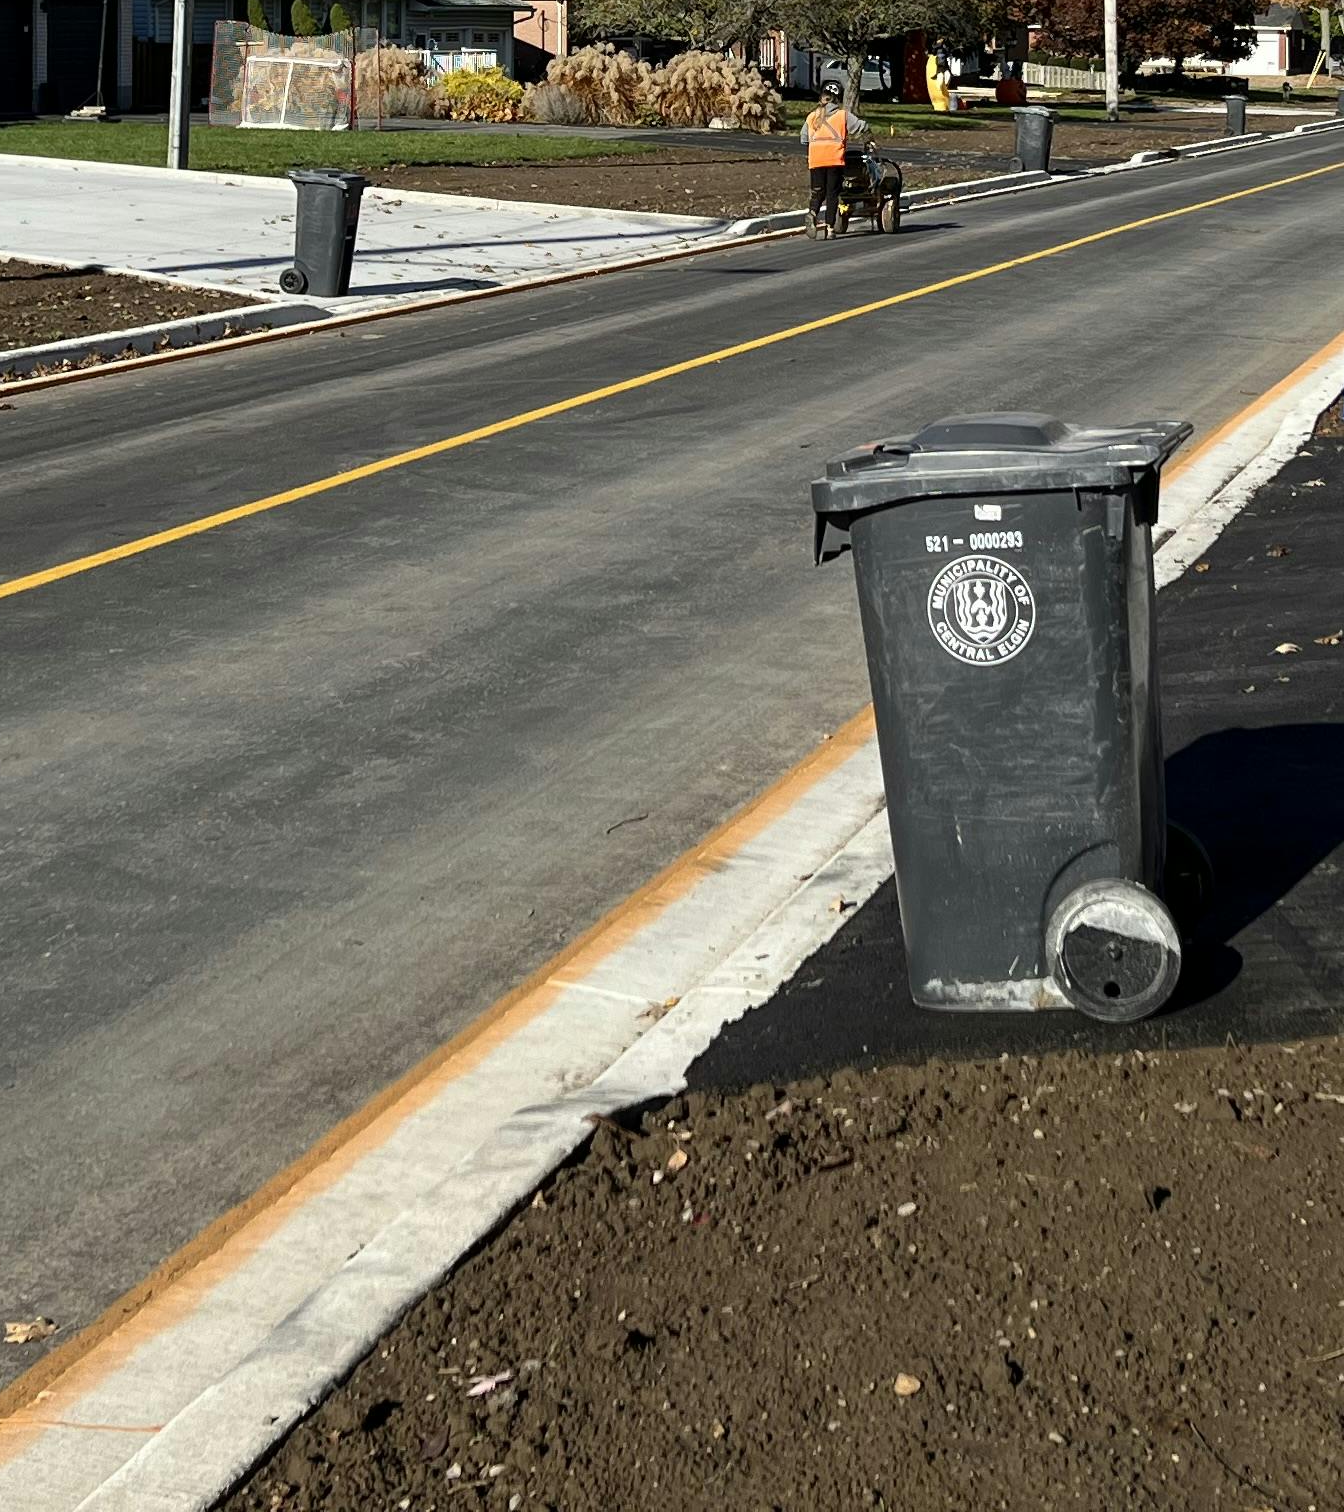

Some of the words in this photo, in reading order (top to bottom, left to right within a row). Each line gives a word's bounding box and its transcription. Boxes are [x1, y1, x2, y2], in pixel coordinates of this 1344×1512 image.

[925, 535, 949, 552] 521
[969, 530, 1023, 550] 0000293
[932, 559, 1017, 609] MUNICIPALITY
[1014, 584, 1030, 606] OF
[936, 621, 995, 661] CENTRAL
[997, 619, 1030, 657] ELGIN
